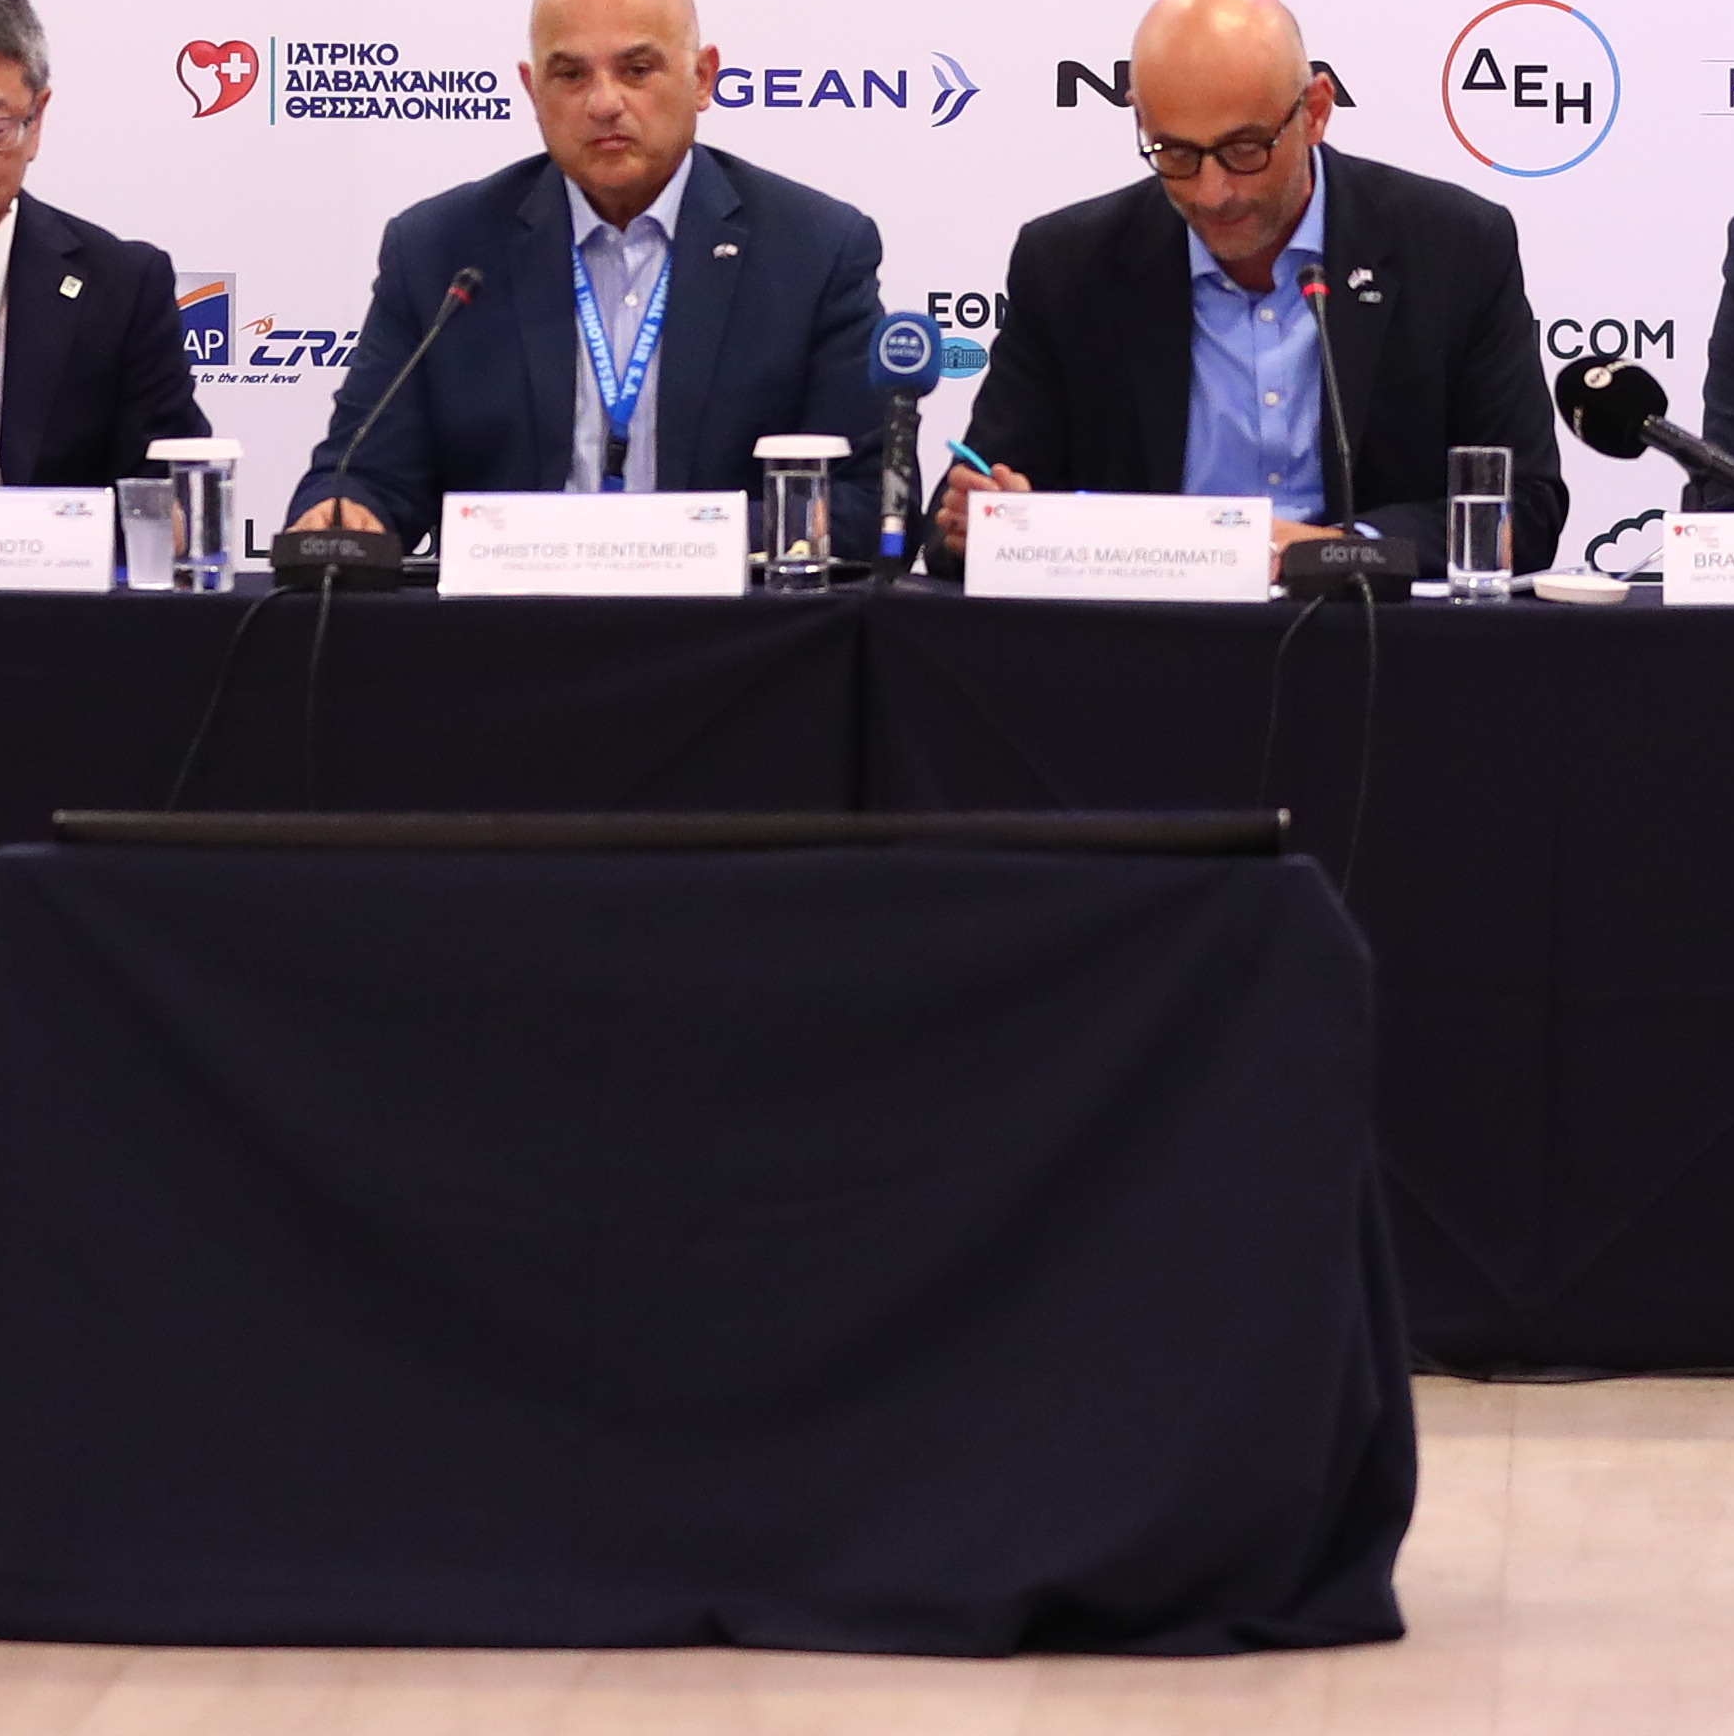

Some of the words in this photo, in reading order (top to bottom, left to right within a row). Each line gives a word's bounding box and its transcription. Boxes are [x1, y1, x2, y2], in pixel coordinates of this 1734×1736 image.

[287, 42, 399, 66] ΙΑΤΡΙΚΟ
[284, 69, 498, 94] ΔΙΑΒΑΛΚΑΝΙΚΟ
[1461, 48, 1592, 125] ΔΕΗ
[285, 96, 511, 120] ΘΕΣΣΑΛΟΝΙΚΗΣ
